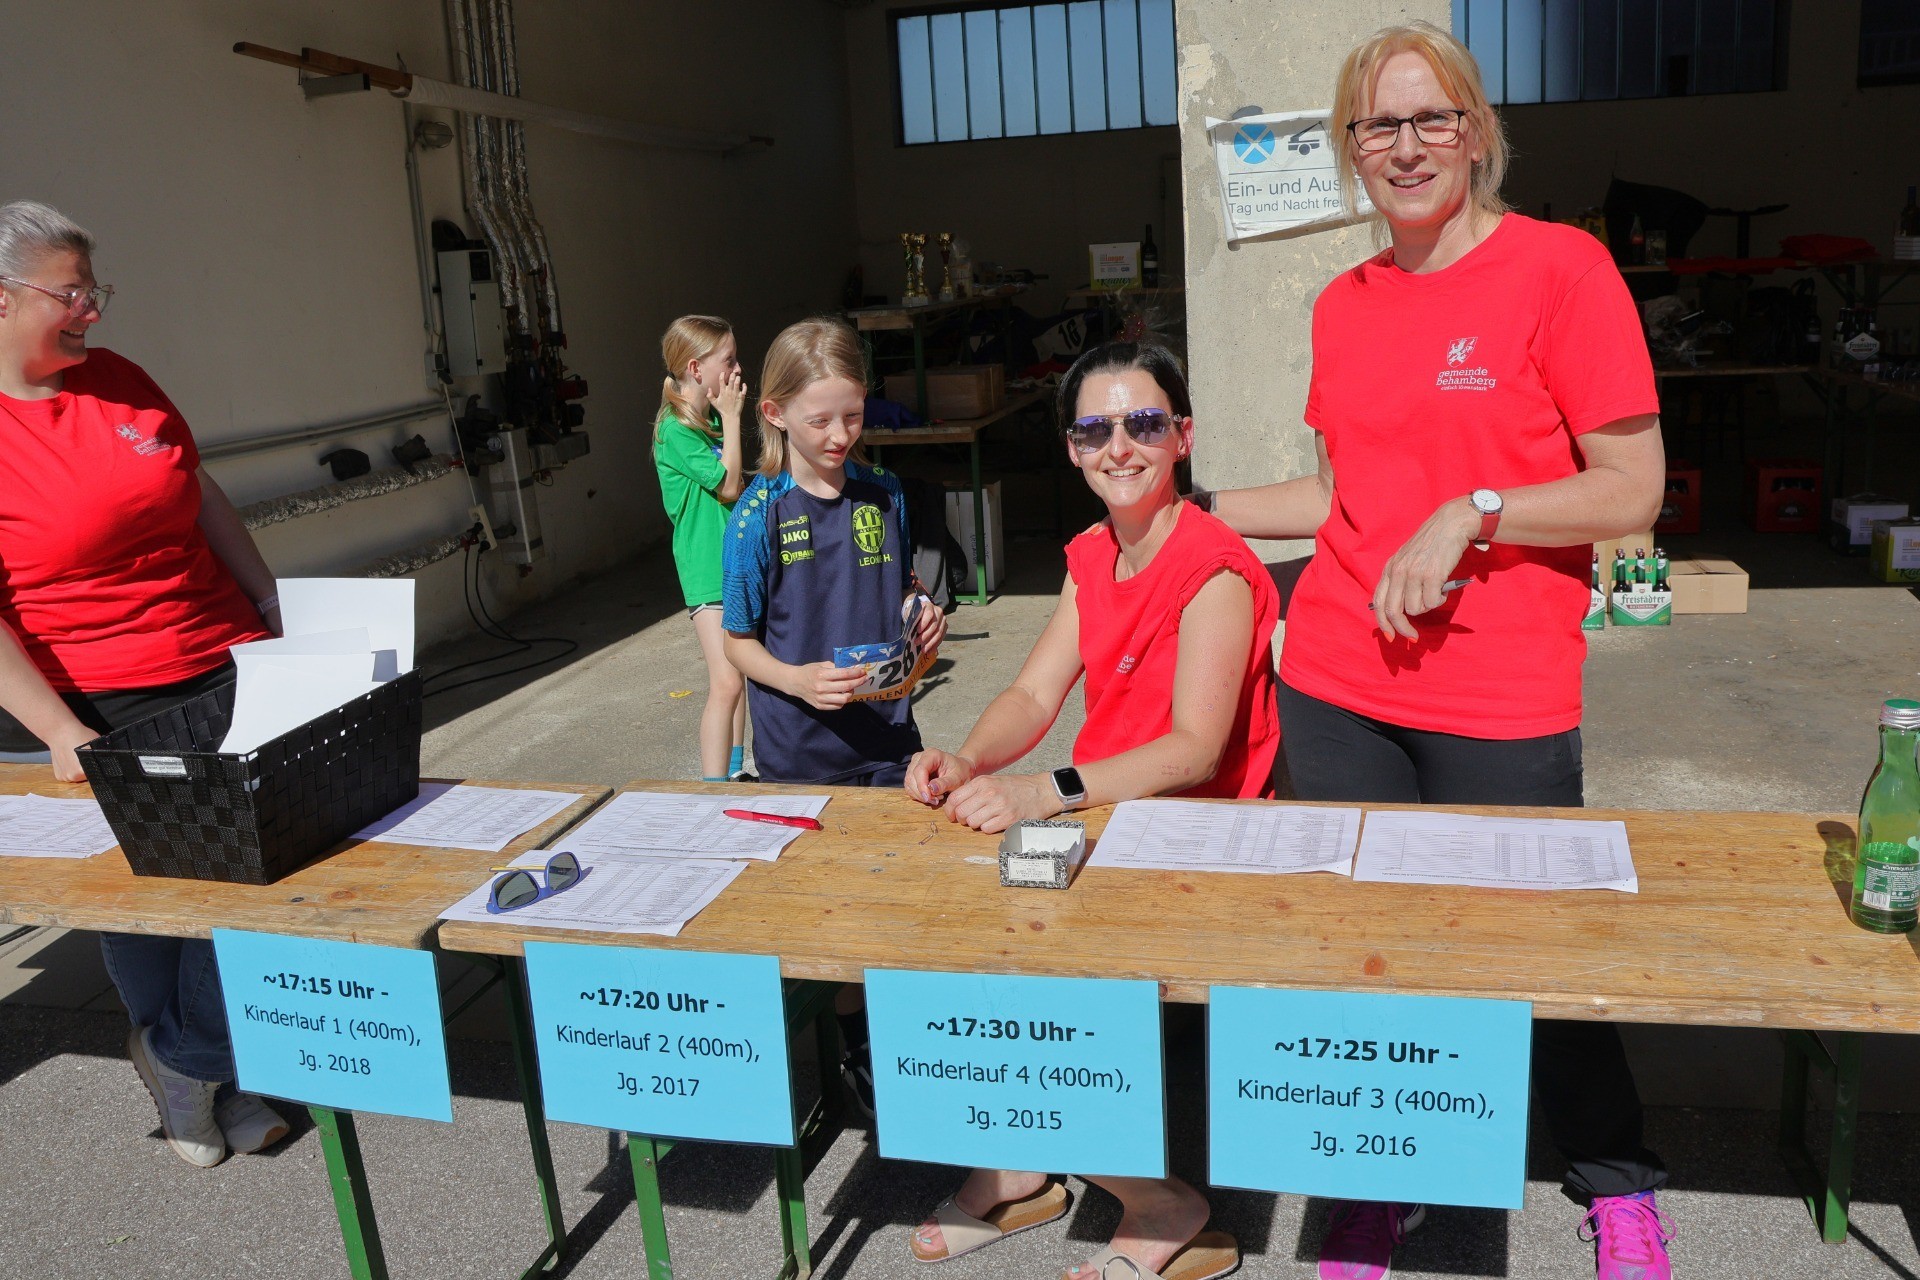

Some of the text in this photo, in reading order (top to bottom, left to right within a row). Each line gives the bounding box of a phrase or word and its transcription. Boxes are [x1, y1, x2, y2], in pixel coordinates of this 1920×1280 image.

[1227, 181, 1263, 198] Ein-
[1269, 178, 1301, 195] und
[1229, 202, 1252, 216] Tag
[1256, 200, 1279, 213] und
[1283, 198, 1320, 211] Nacht
[1436, 376, 1496, 388] behamberg
[1438, 367, 1488, 378] gemeinde
[782, 529, 810, 545] JAKO
[263, 972, 332, 995] ~17:15
[338, 979, 375, 1000] Uhr
[580, 987, 660, 1011] ~17:20
[667, 993, 709, 1013] Uhr
[244, 1003, 421, 1047] Kinderlauf 1 (400m),
[927, 1017, 1020, 1039] ~17:30
[1029, 1021, 1077, 1042] Uhr
[556, 1024, 760, 1063] Kinderlauf 2 (400m),
[1274, 1037, 1378, 1062] ~17:25
[1388, 1041, 1440, 1064] Uhr
[299, 1049, 371, 1075] Jg. 2018
[897, 1056, 1132, 1093] Kinderlauf 4 (400m),
[617, 1072, 700, 1097] Jg. 2017
[1238, 1078, 1495, 1120] Kinderlauf 3 (400m),
[966, 1105, 1063, 1130] Jg. 2015
[1310, 1131, 1417, 1157] Jg. 2016
